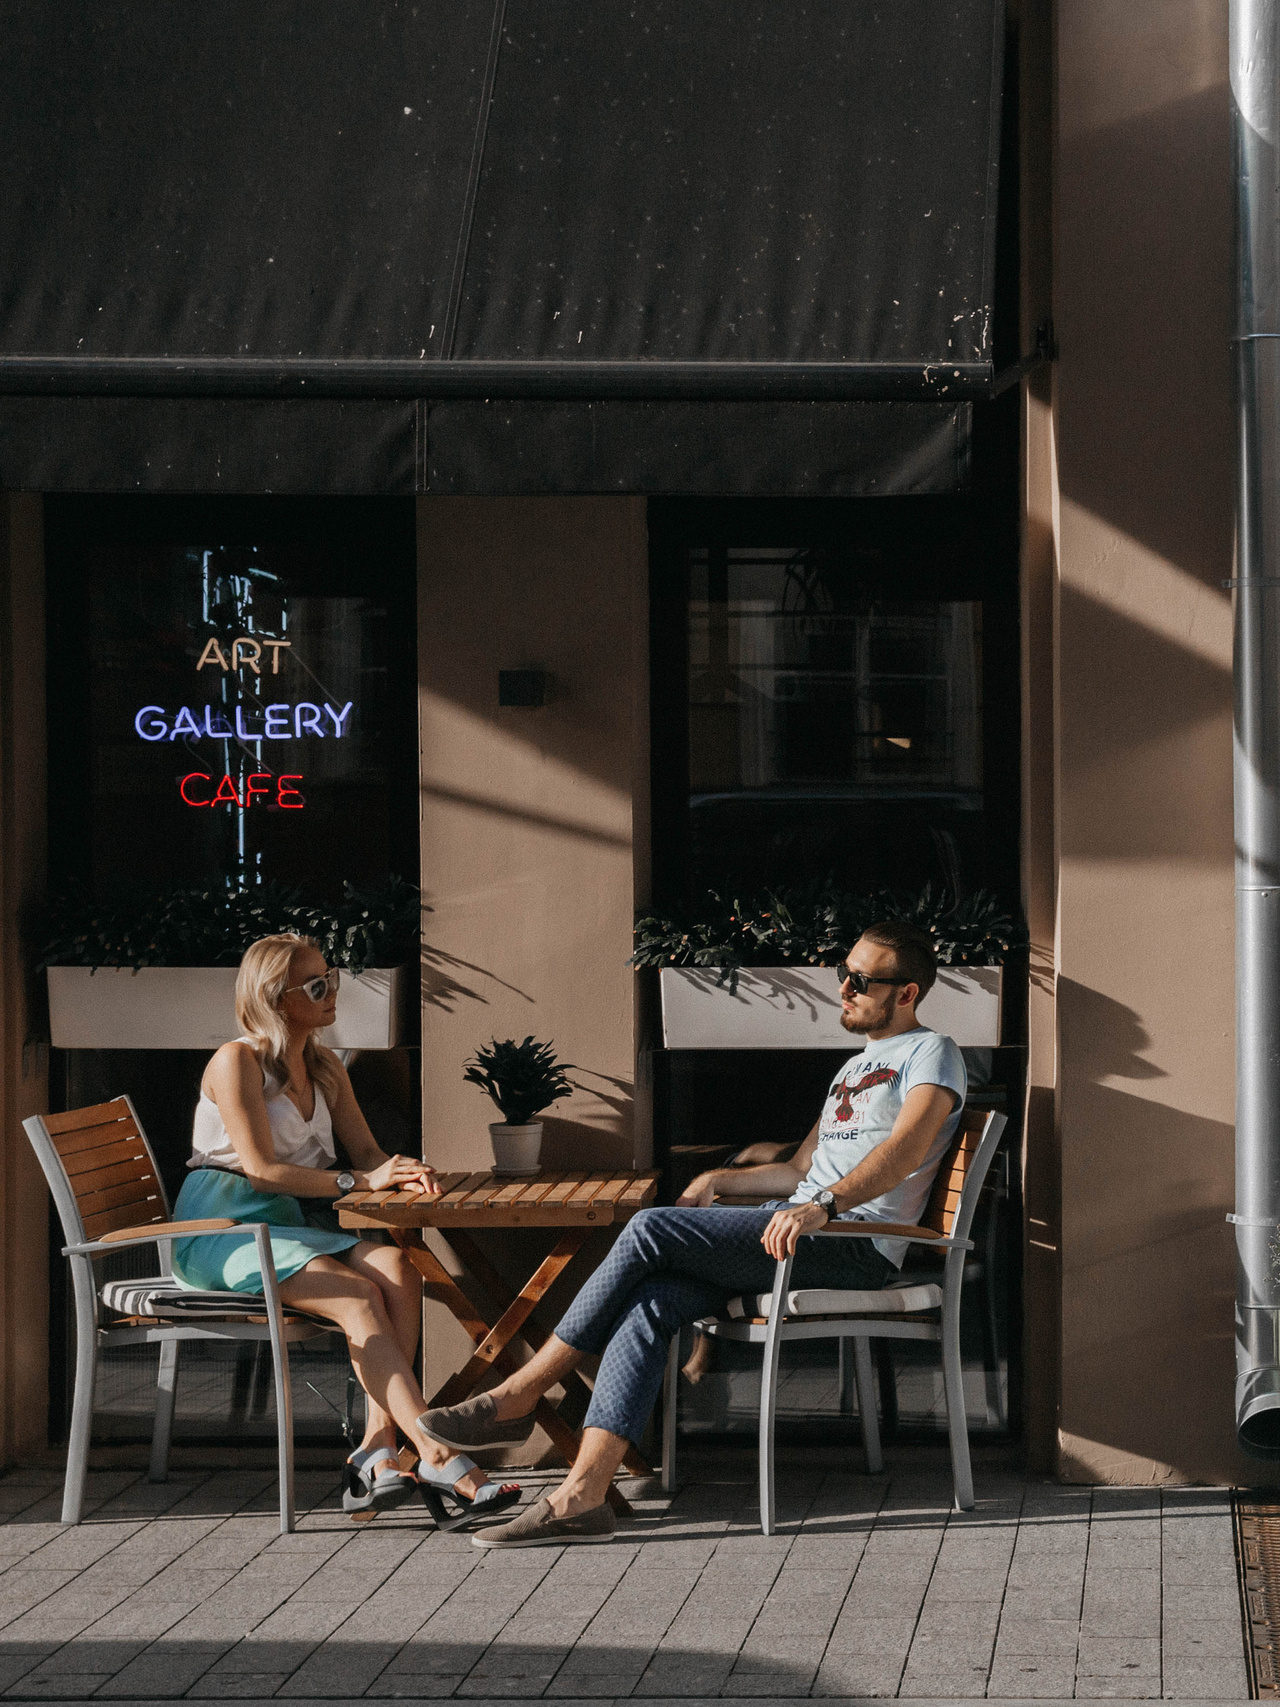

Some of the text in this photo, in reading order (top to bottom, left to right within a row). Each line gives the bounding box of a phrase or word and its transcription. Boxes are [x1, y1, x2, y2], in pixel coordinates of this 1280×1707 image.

[196, 637, 292, 674] ART
[135, 701, 353, 741] GALLERY
[180, 772, 304, 809] CAFE
